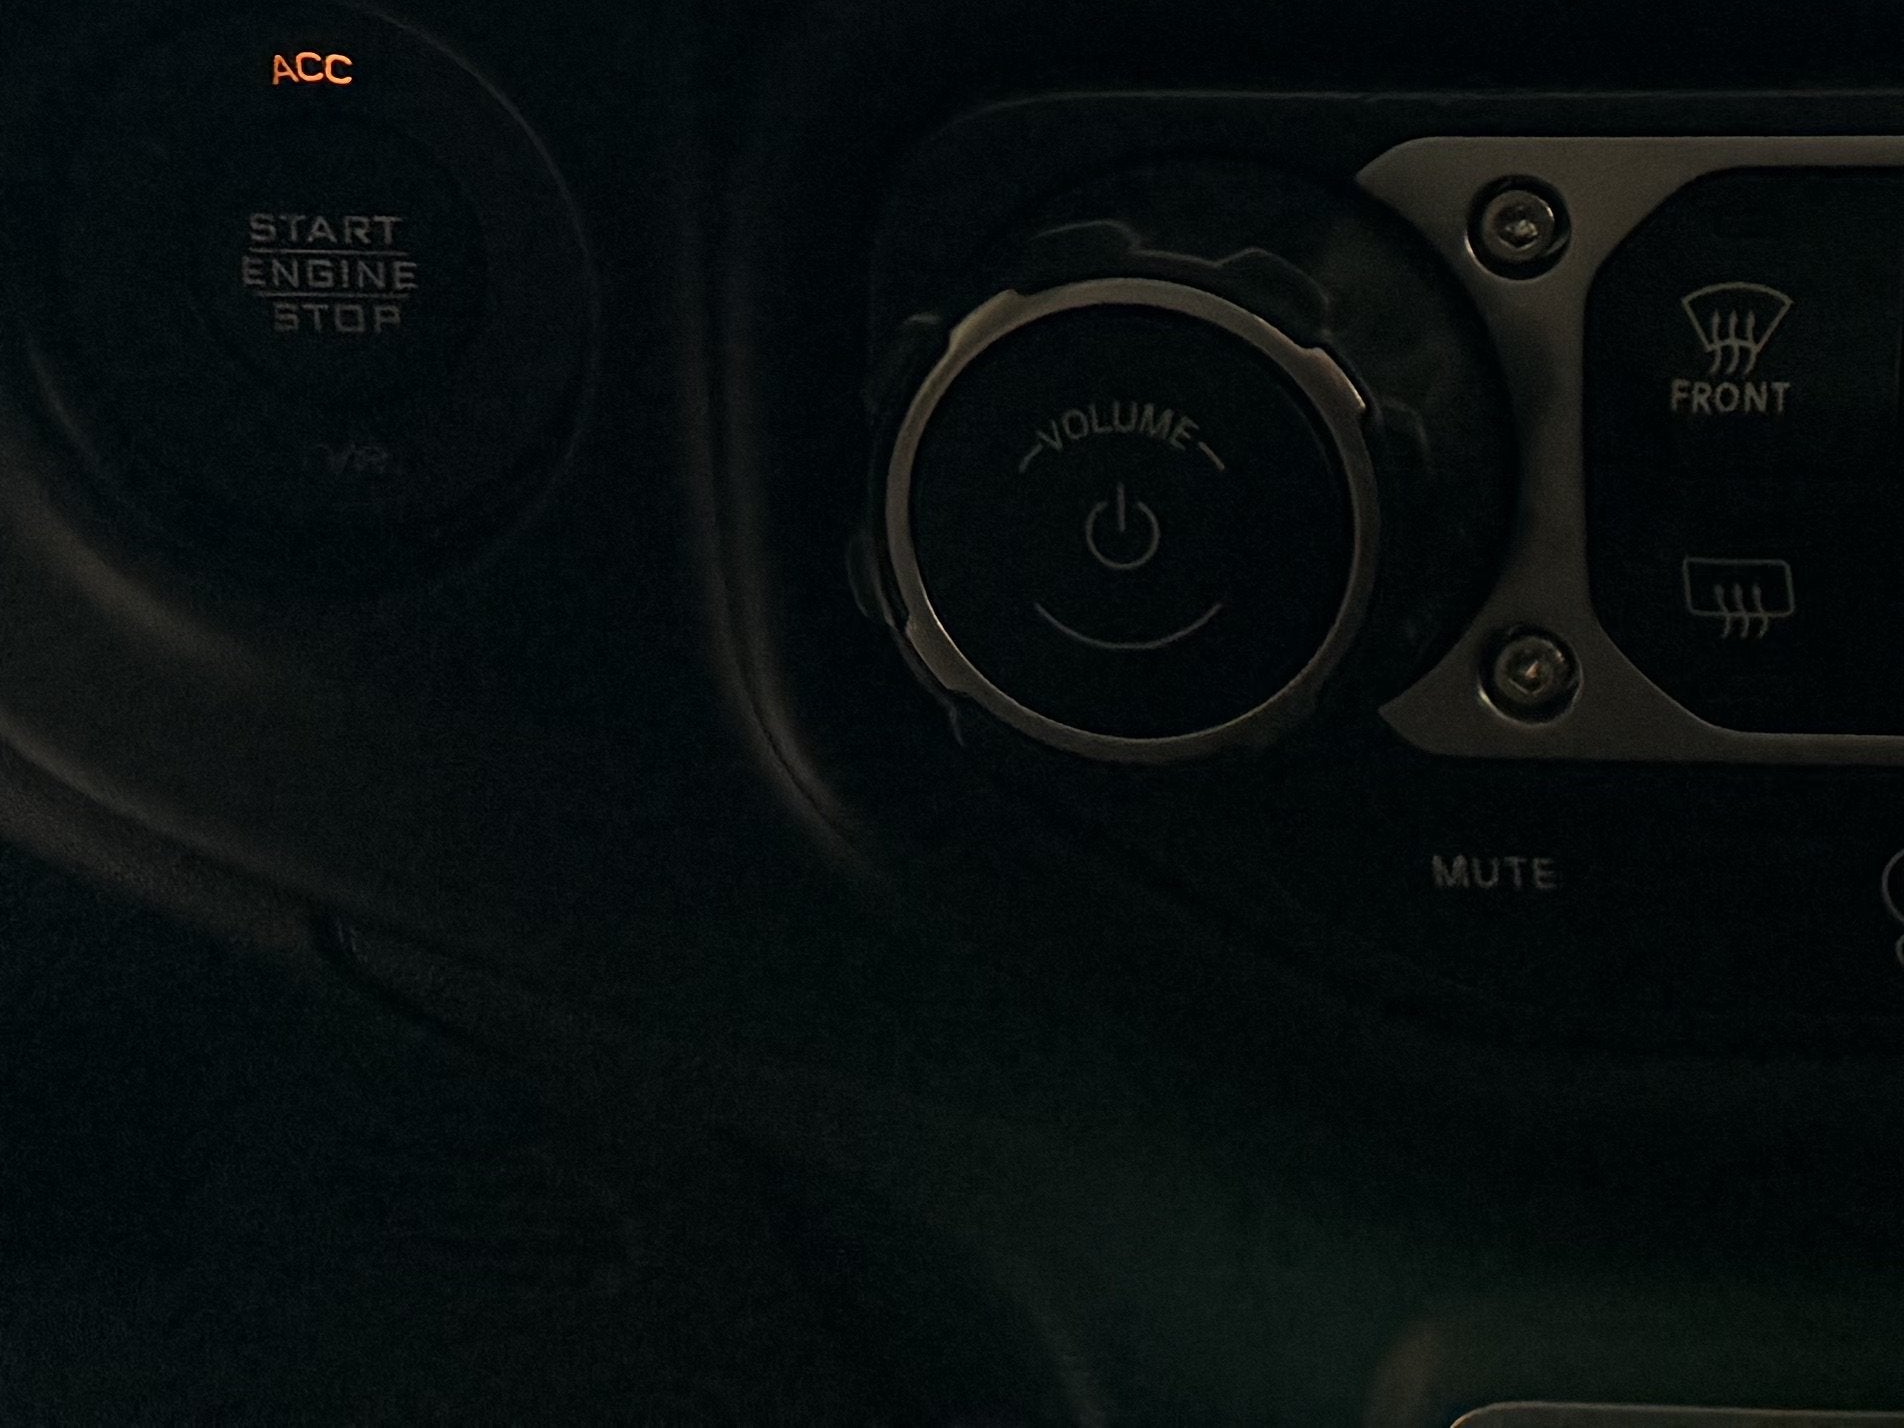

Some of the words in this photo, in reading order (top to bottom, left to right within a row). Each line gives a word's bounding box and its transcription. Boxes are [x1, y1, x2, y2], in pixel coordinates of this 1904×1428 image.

[270, 50, 354, 88] ACC
[248, 212, 402, 247] START
[241, 256, 418, 293] ENGINE
[271, 299, 403, 335] STOP
[1670, 379, 1790, 417] FRONT
[1036, 400, 1200, 454] VOLUME
[1432, 854, 1558, 891] MUTE
